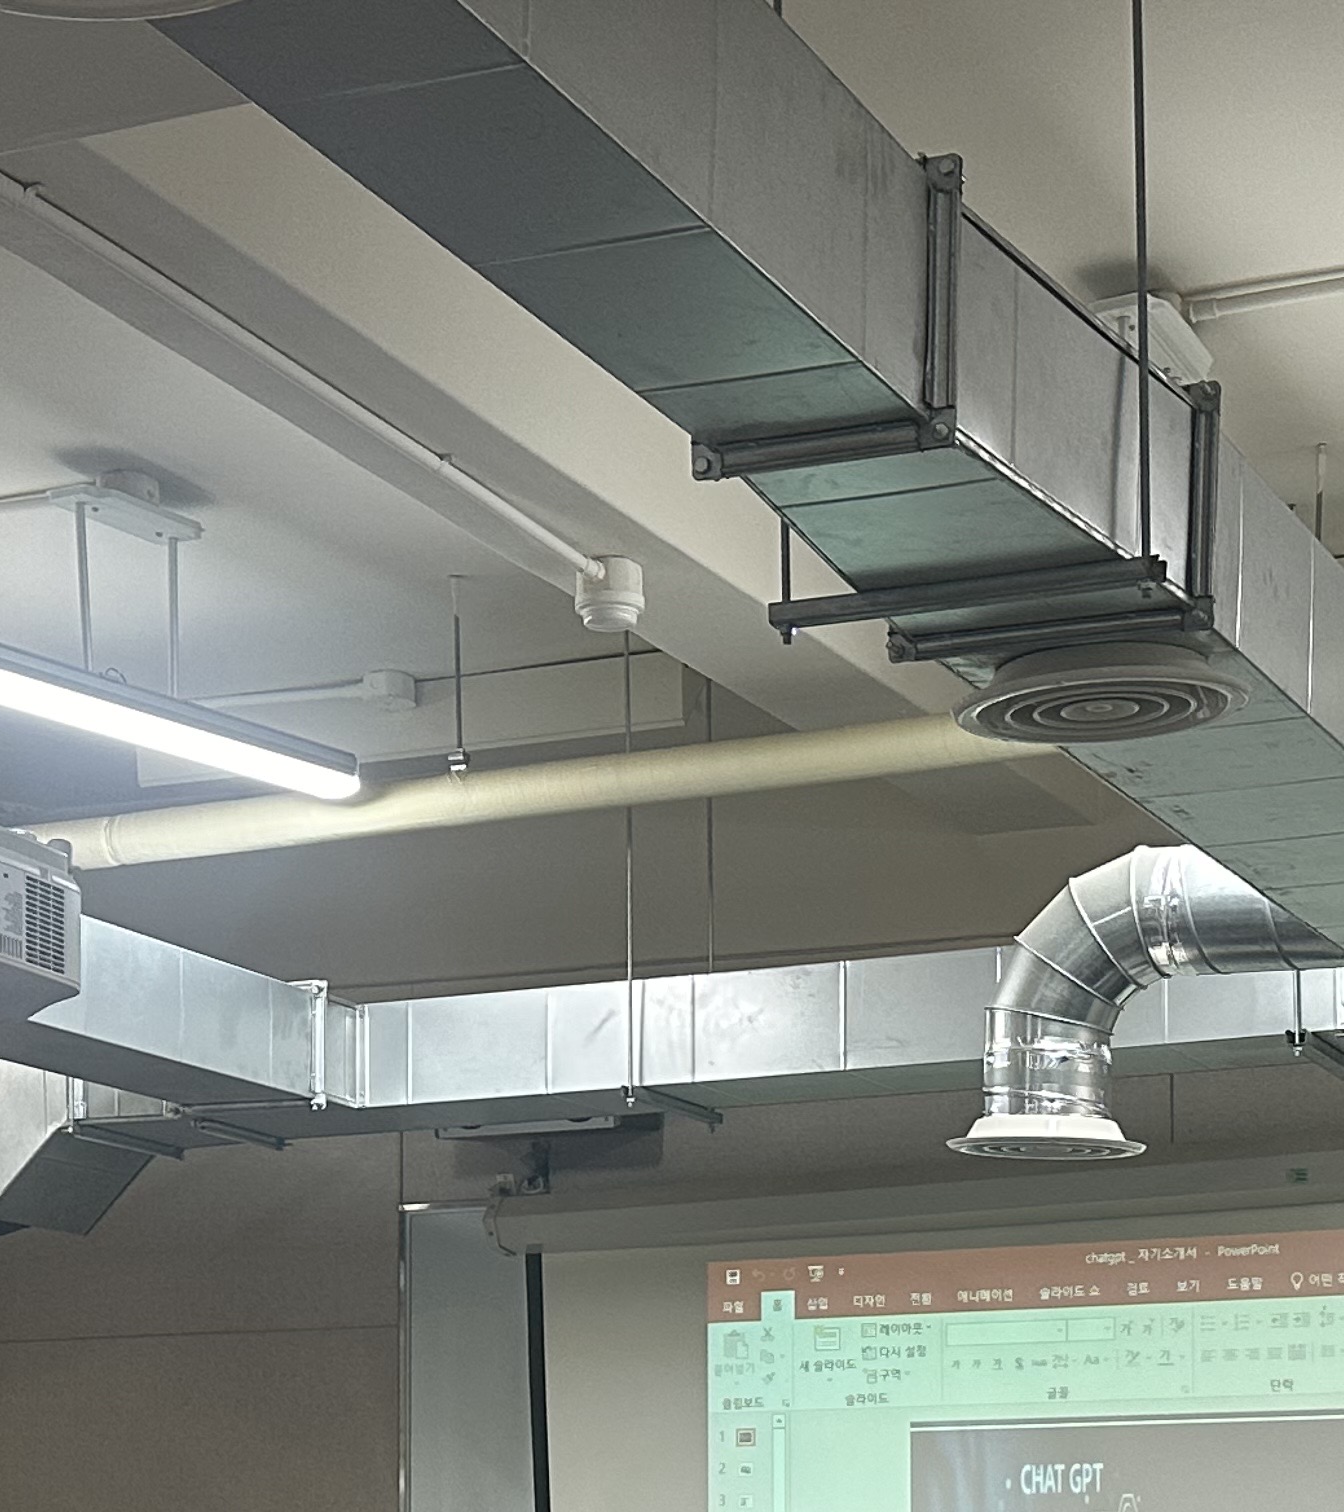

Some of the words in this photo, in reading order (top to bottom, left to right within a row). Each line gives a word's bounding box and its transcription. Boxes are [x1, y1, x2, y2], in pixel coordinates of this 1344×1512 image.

[1085, 1251, 1126, 1267] chatgpt
[1137, 1247, 1197, 1261] 자기소개서
[1217, 1243, 1281, 1257] PowerPoint
[1176, 1279, 1200, 1293] 보기
[1226, 1276, 1264, 1291] 도움말
[1308, 1272, 1333, 1287] 어떤
[956, 1288, 1014, 1302] 애니메이션
[1039, 1284, 1086, 1300] 슬라이드
[1126, 1281, 1150, 1296] 검토
[807, 1296, 829, 1311] 삽입
[852, 1294, 886, 1308] 디자인
[909, 1292, 932, 1306] 전환
[722, 1300, 744, 1314] 파일
[879, 1322, 924, 1336] 레이아웃
[879, 1346, 901, 1358] 다시
[905, 1344, 927, 1358] 설정
[799, 1359, 810, 1372] 새
[813, 1358, 857, 1372] 슬라이드
[879, 1368, 902, 1382] 구역
[1270, 1378, 1294, 1392] 단락
[845, 1392, 890, 1407] 슬라이드
[1020, 1463, 1065, 1495] CHAT
[1069, 1462, 1104, 1494] GPT
